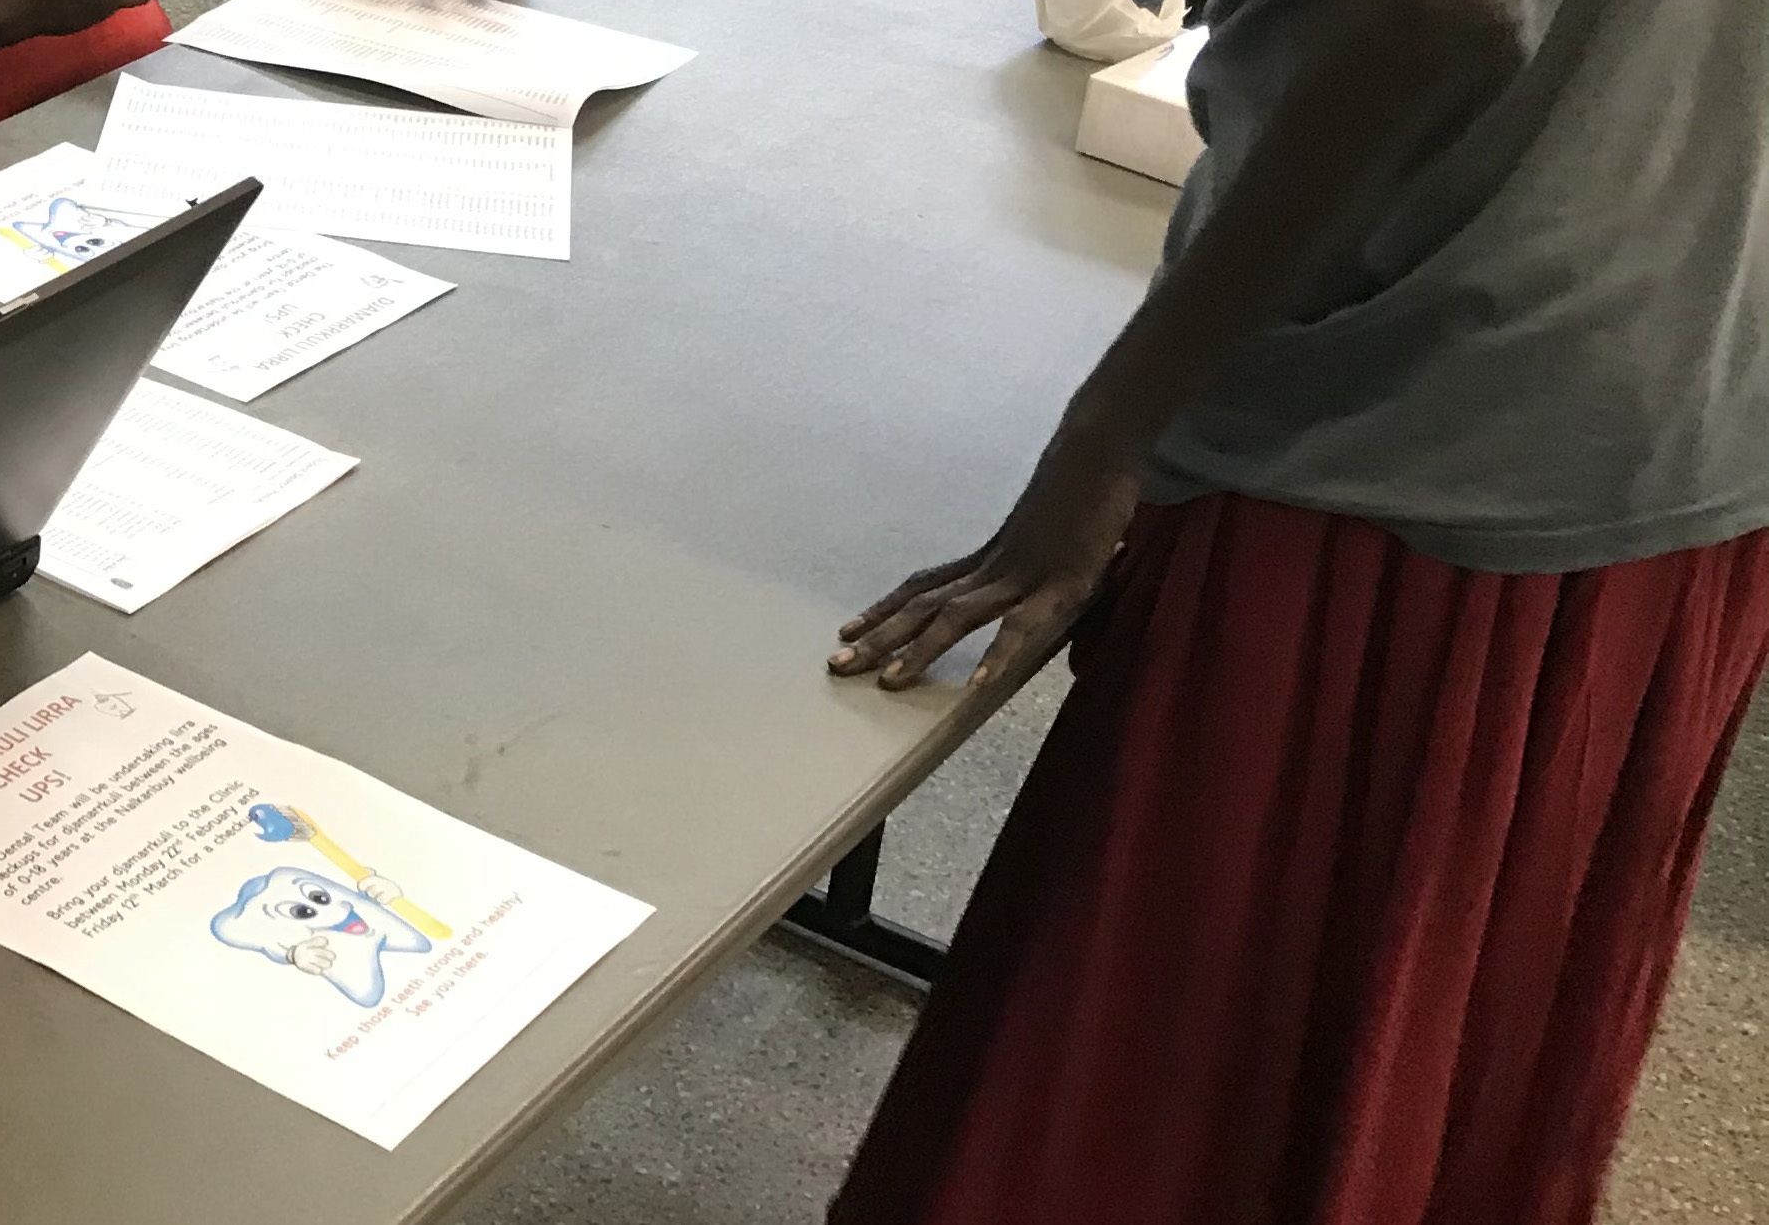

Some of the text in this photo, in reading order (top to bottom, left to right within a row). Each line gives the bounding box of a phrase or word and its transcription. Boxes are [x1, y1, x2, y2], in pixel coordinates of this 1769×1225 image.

[277, 312, 327, 340] CHECK
[21, 695, 83, 733] LIRRA
[3, 884, 18, 898] of
[17, 864, 47, 885] 0-18
[46, 842, 81, 869] years
[79, 830, 96, 844] at
[94, 814, 118, 833] the
[174, 737, 228, 776] wellbeing
[18, 769, 72, 804] UPS!
[31, 809, 70, 834] Team
[70, 793, 91, 810] will
[88, 781, 109, 796] be
[108, 735, 175, 783] undertaking
[168, 719, 196, 738] lirra
[37, 834, 60, 851] for
[61, 790, 124, 837] djamarrkuli
[119, 757, 171, 793] between
[169, 742, 193, 759] the
[191, 723, 219, 744] ages
[20, 874, 64, 907] centre.
[46, 779, 245, 921] Bring your djamarrkuli to the Clinic
[63, 891, 119, 930] between
[115, 857, 167, 894] Monday
[184, 804, 239, 843] February
[237, 787, 261, 807] and
[81, 910, 125, 939] Friday
[142, 867, 184, 896] March
[179, 851, 203, 869] for
[202, 844, 215, 854] a
[323, 1034, 360, 1061] Keep
[357, 1005, 394, 1034] those
[390, 977, 425, 1005] teeth
[424, 946, 465, 977] strong
[460, 926, 484, 947] and
[404, 950, 489, 1017] See you there.
